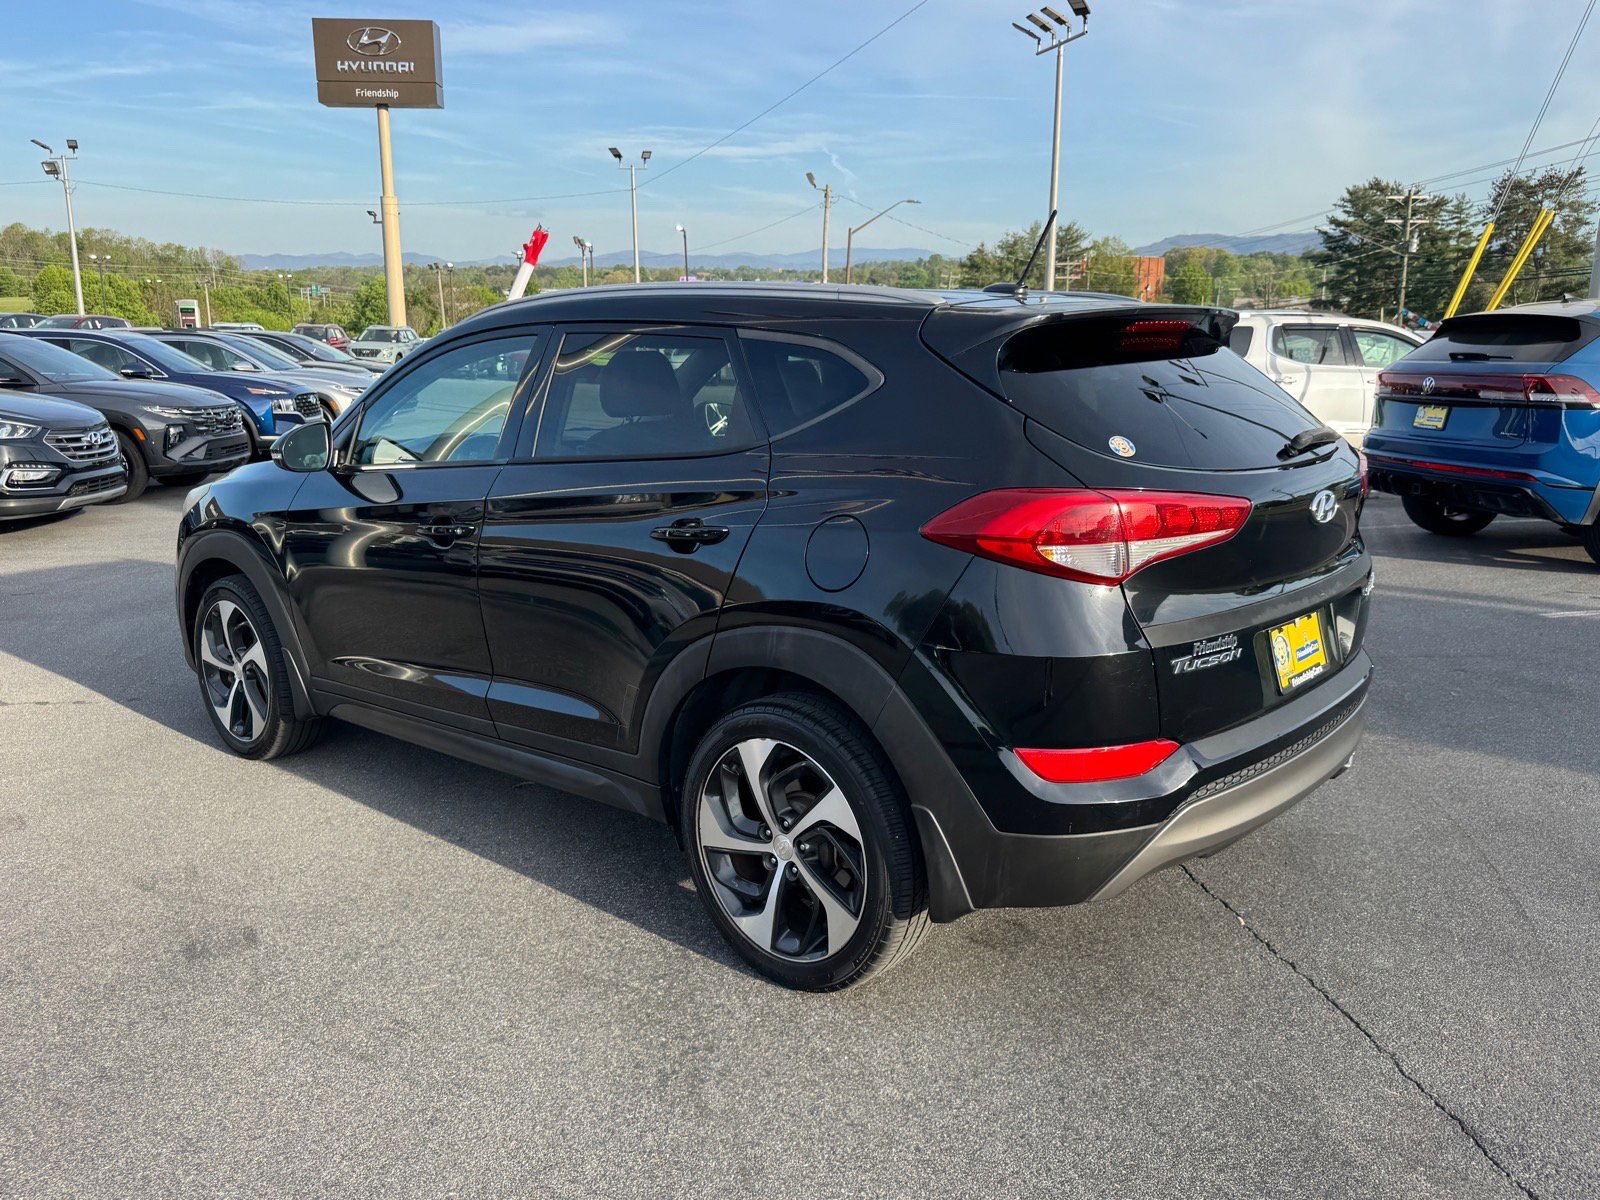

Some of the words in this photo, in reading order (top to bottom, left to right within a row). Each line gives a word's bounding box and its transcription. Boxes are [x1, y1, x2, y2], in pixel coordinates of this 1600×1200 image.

[337, 60, 415, 73] HYUNDAI
[355, 88, 399, 99] Friendship
[1193, 634, 1238, 657] Friendship
